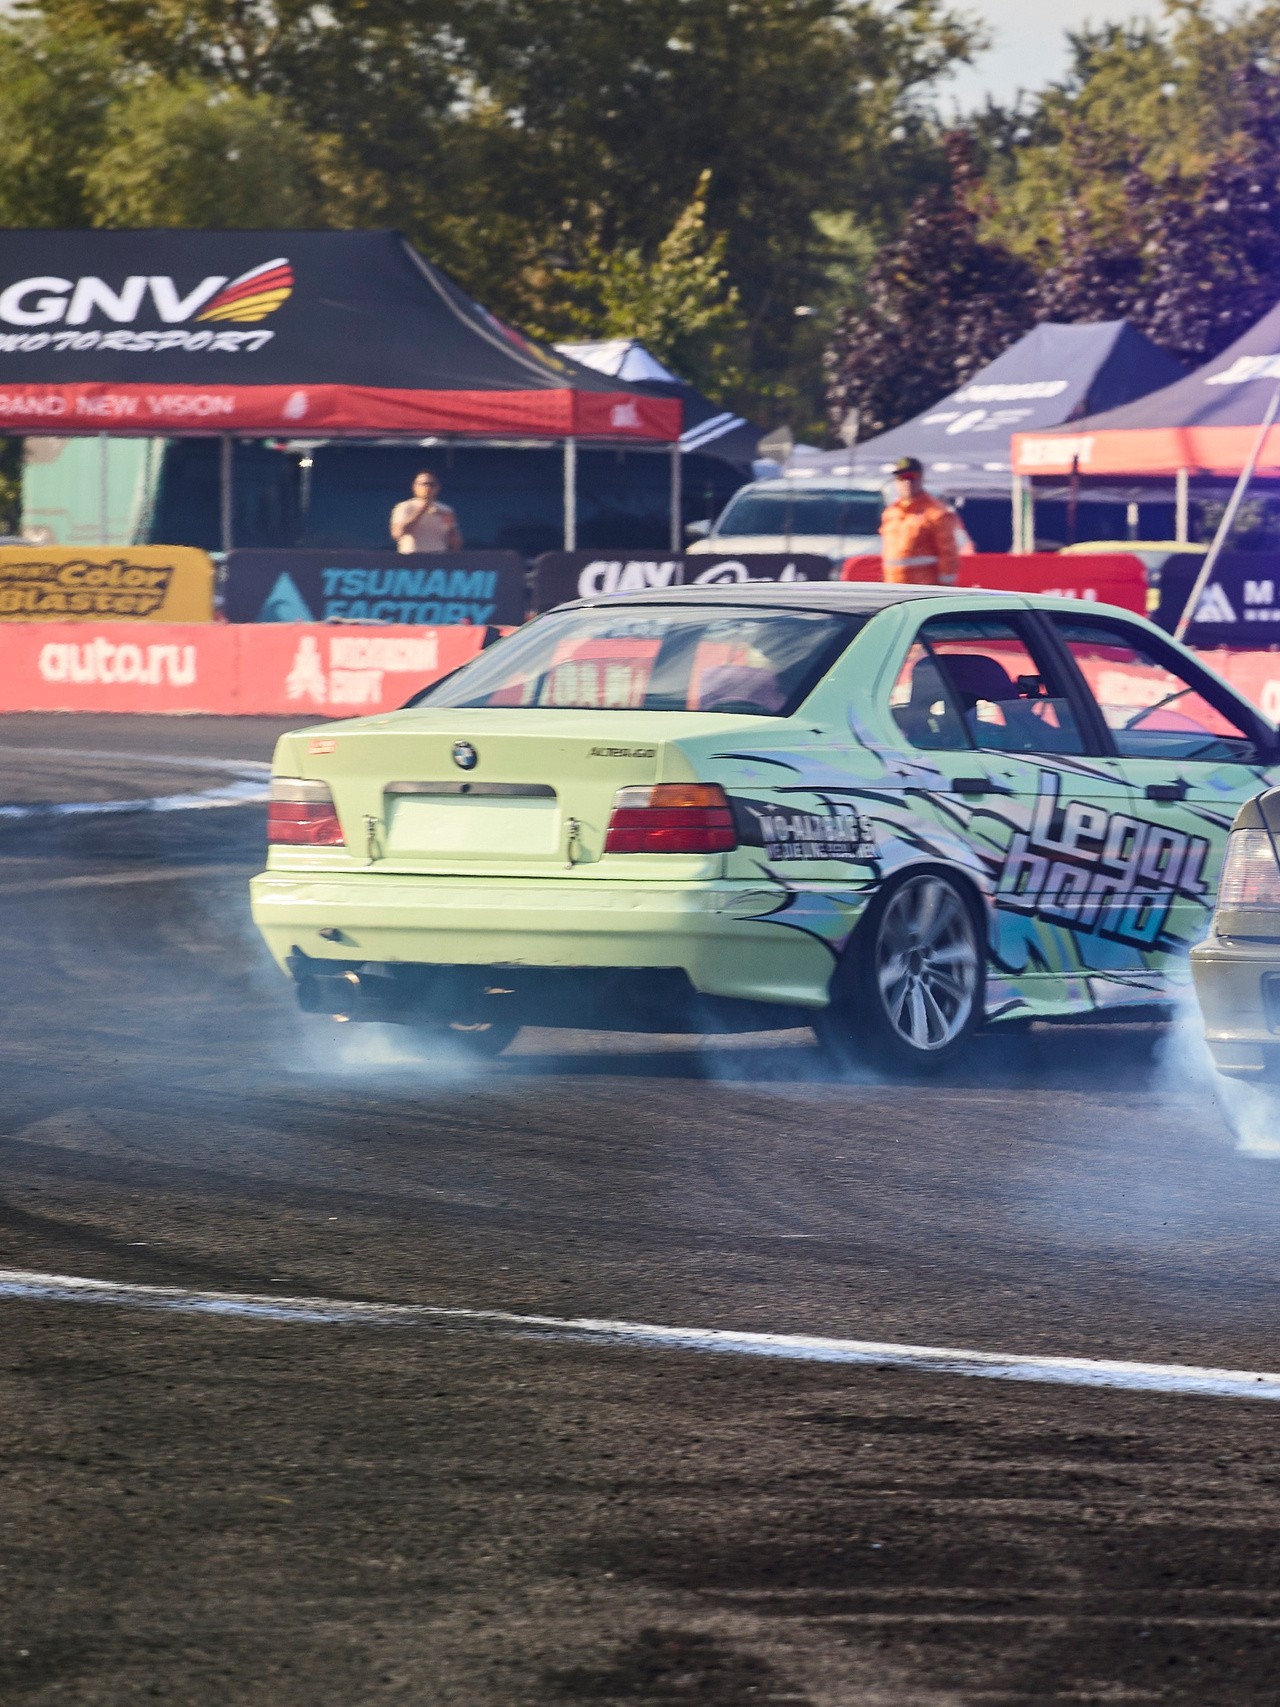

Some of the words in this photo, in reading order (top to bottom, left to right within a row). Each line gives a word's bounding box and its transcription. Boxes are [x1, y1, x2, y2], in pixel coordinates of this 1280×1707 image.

[0, 276, 229, 326] GNV
[75, 394, 140, 416] NEW
[146, 394, 236, 416] VISION
[57, 560, 174, 588] Color
[321, 567, 498, 599] TSUNAMI
[324, 600, 497, 625] FACTORY
[38, 636, 197, 687] auto.ru
